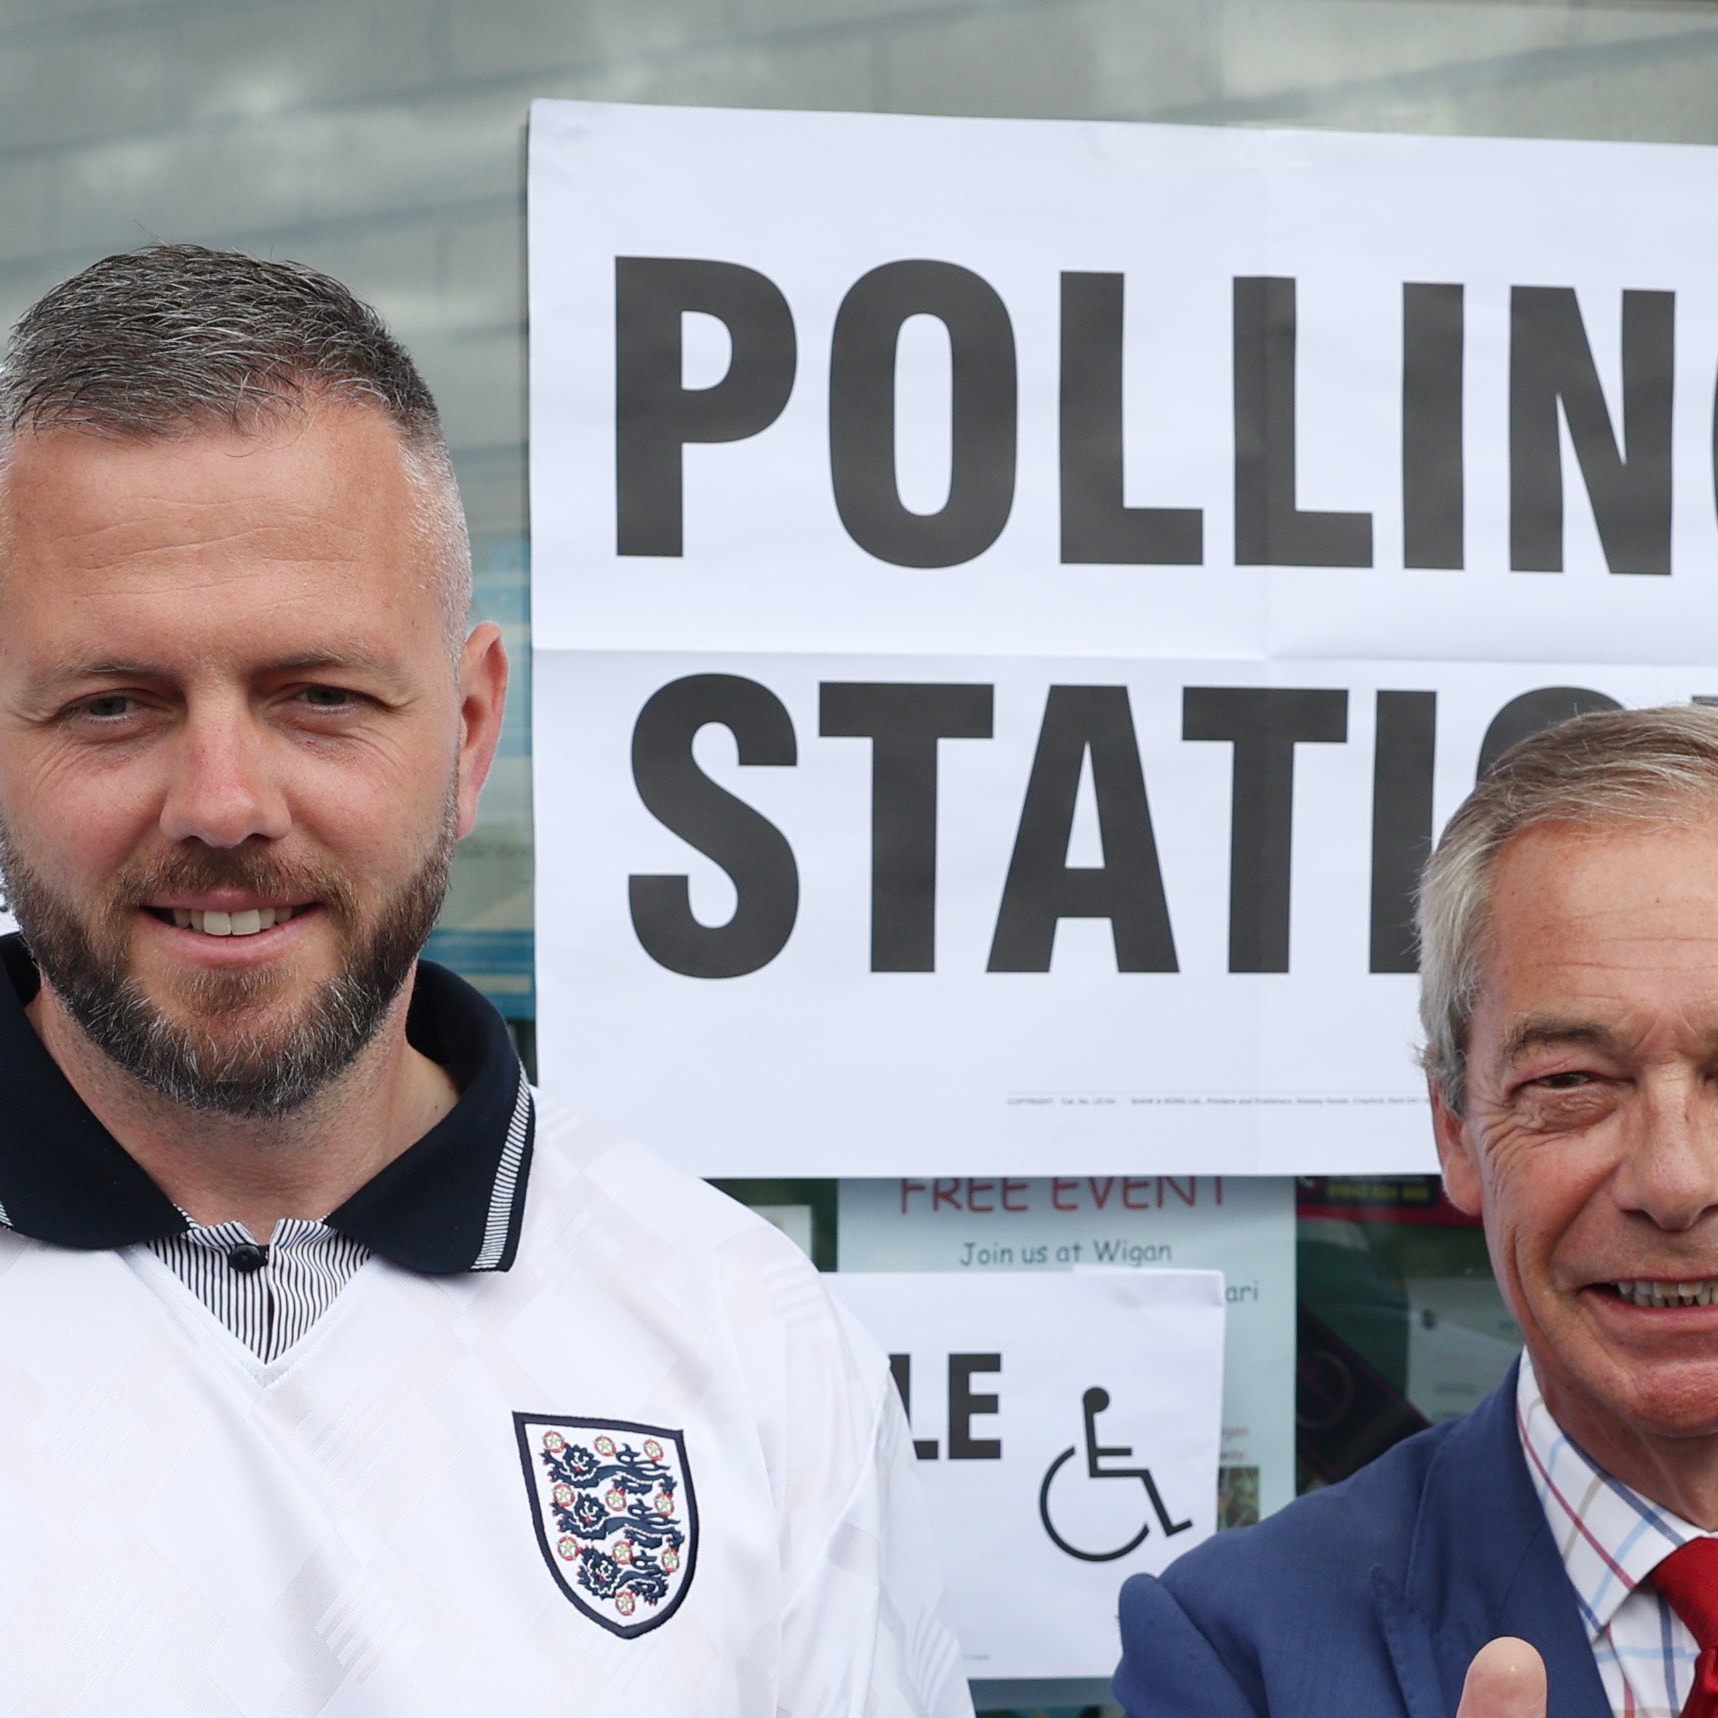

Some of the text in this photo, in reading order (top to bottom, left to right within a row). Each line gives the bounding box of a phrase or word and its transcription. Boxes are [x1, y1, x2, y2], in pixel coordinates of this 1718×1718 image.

[900, 1175, 1225, 1214] FREE EVENT
[959, 1239, 1172, 1268] Join us at Wigan
